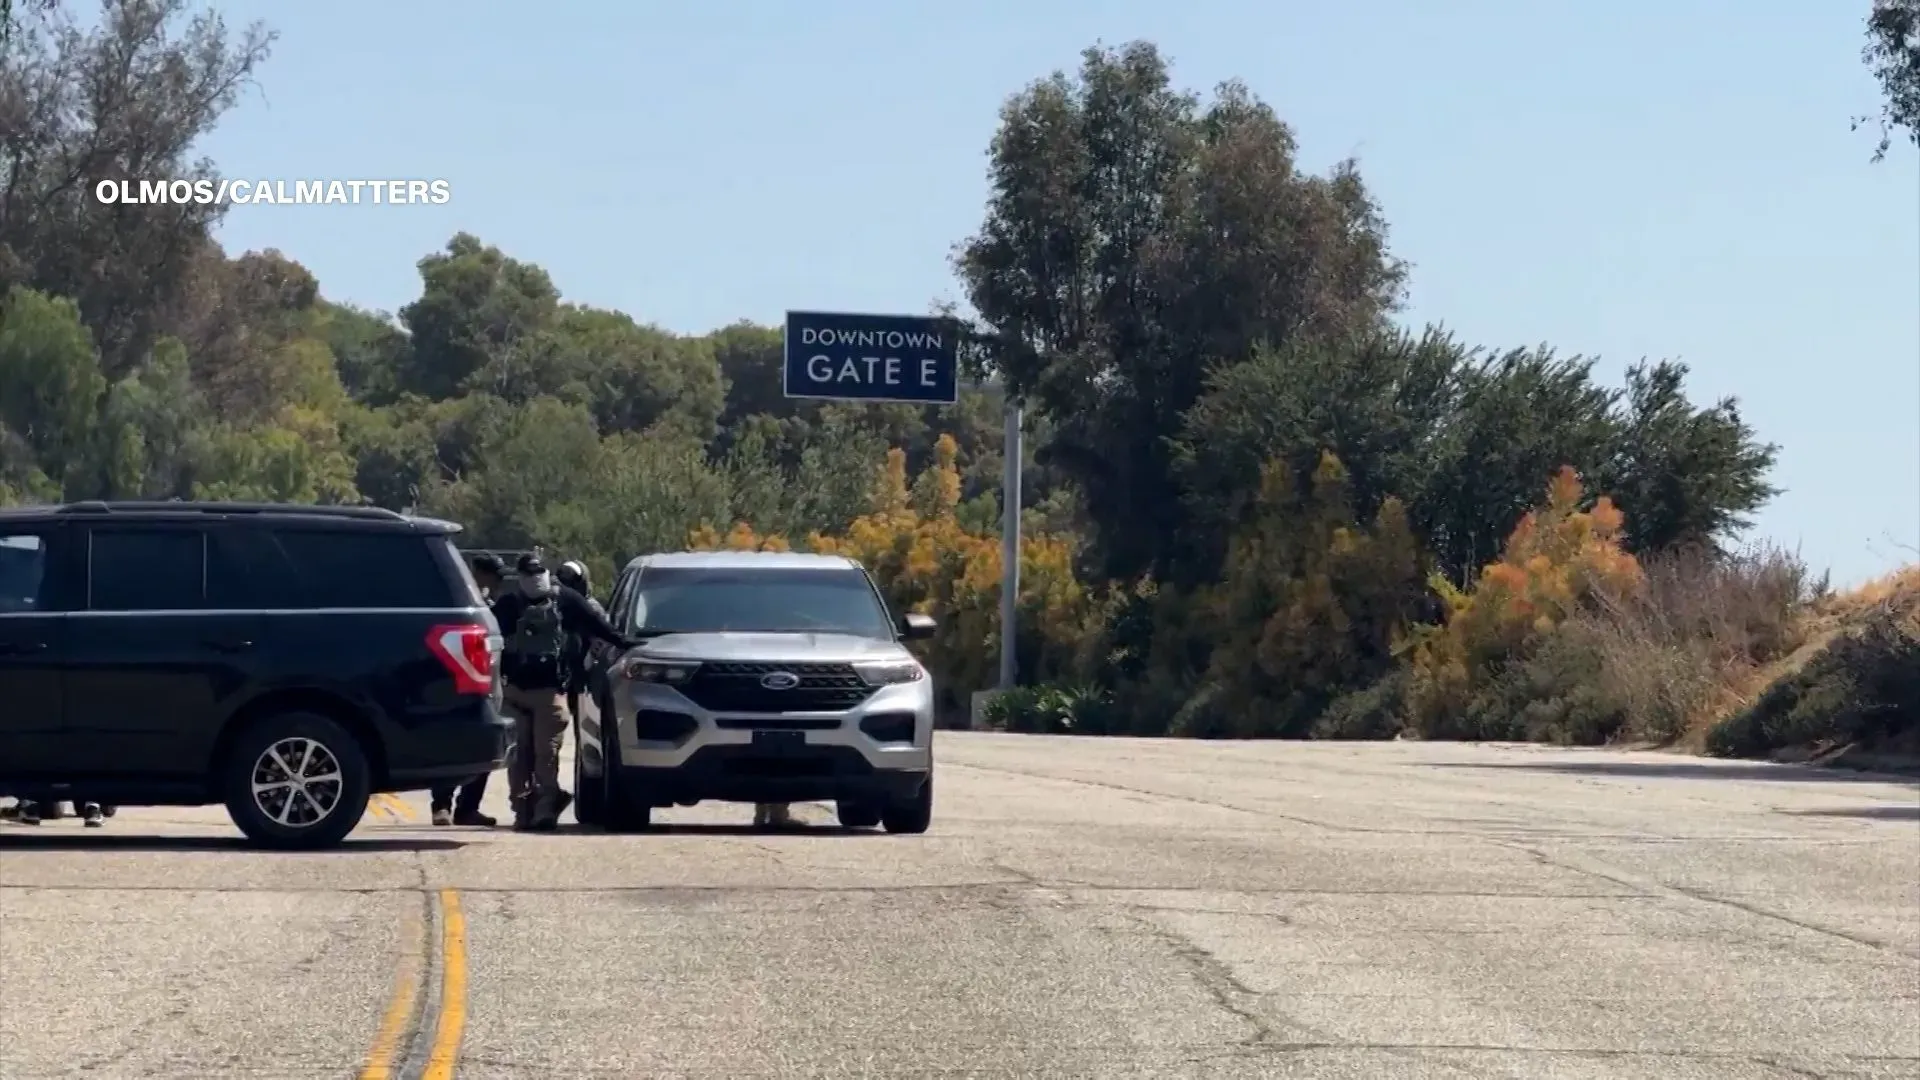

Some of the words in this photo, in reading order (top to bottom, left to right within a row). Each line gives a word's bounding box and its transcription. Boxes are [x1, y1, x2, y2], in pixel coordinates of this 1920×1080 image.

[802, 328, 942, 350] DOWNTOWN
[807, 355, 901, 385] GATE
[920, 358, 937, 386] E
